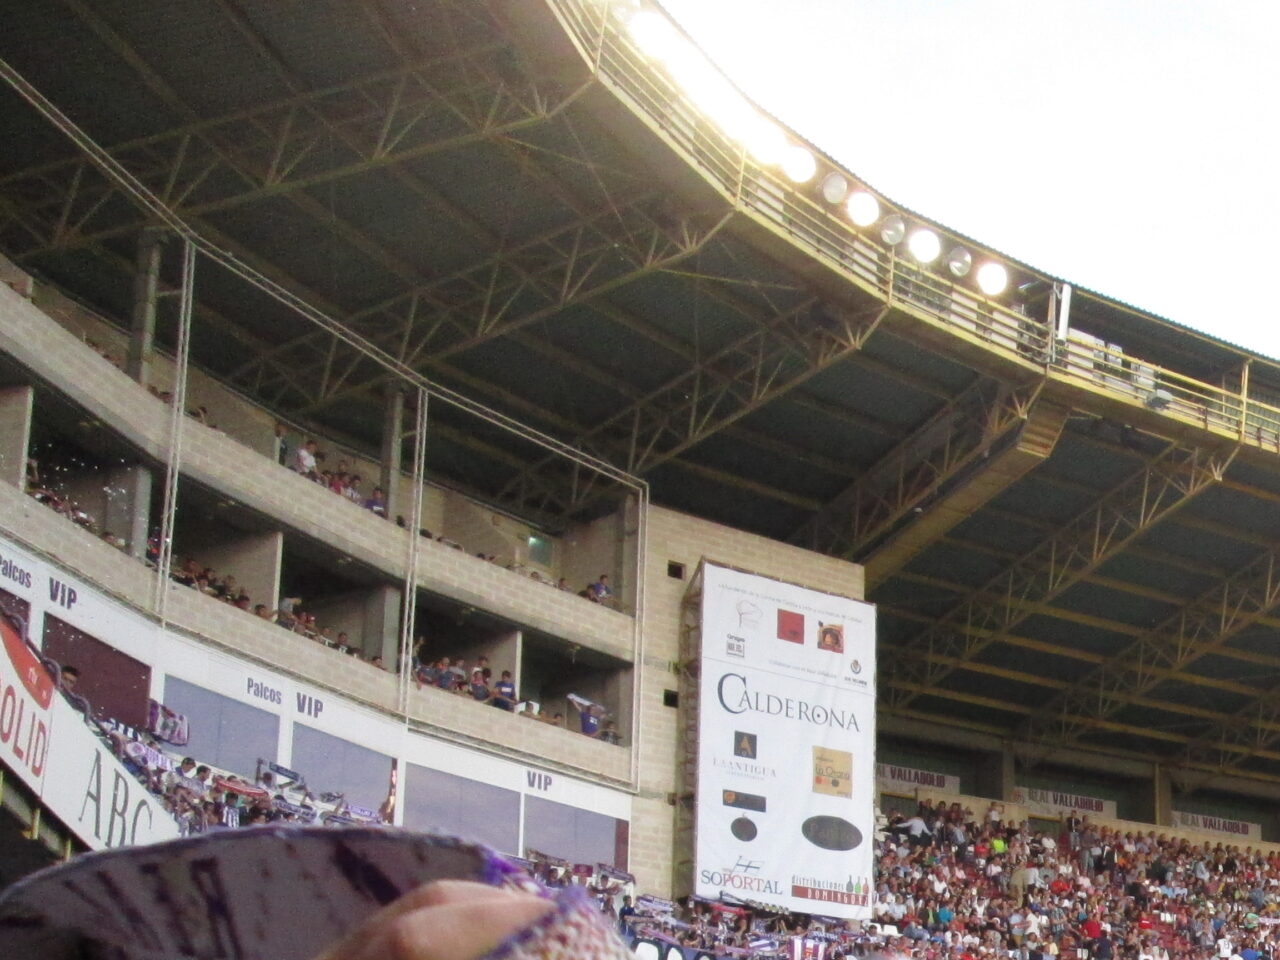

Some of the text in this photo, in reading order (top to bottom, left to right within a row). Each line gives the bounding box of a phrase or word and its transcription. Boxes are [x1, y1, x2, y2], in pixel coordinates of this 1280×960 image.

[49, 576, 78, 610] VIP
[246, 676, 324, 719] Palcos VIP
[717, 672, 861, 733] CALDERONA
[526, 770, 553, 792] VIP
[890, 767, 946, 788] VALLADOLID
[78, 747, 154, 849] ABC
[1052, 790, 1104, 813] VALLADOLID
[1202, 814, 1250, 836] VALLADOLID
[701, 868, 783, 896] SOPORTAL
[791, 874, 845, 892] distribuciones
